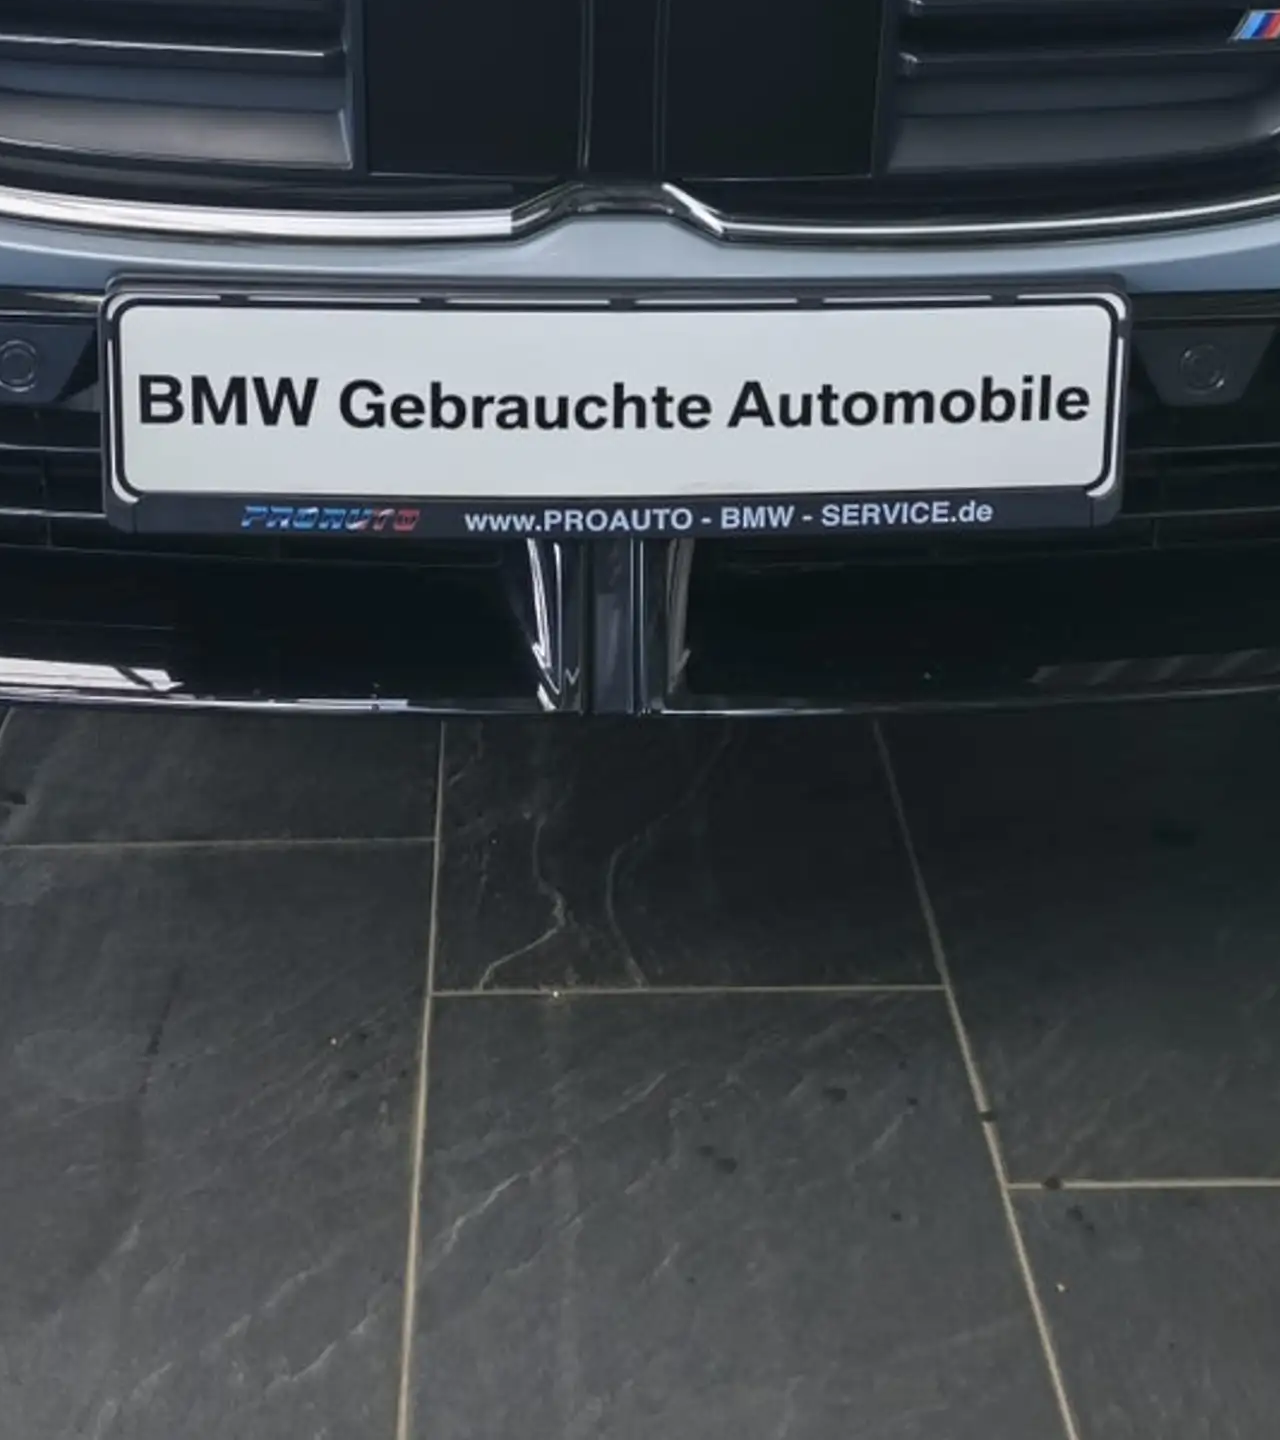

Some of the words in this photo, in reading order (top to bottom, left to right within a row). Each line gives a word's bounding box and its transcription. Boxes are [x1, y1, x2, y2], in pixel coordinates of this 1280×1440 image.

[139, 374, 319, 427] BMW
[339, 379, 712, 430] Gebrauchte
[727, 374, 1090, 428] Automobile
[464, 508, 694, 534] www.PROAUTO
[720, 505, 796, 529] BMW
[821, 500, 994, 527] SERVICE.de
